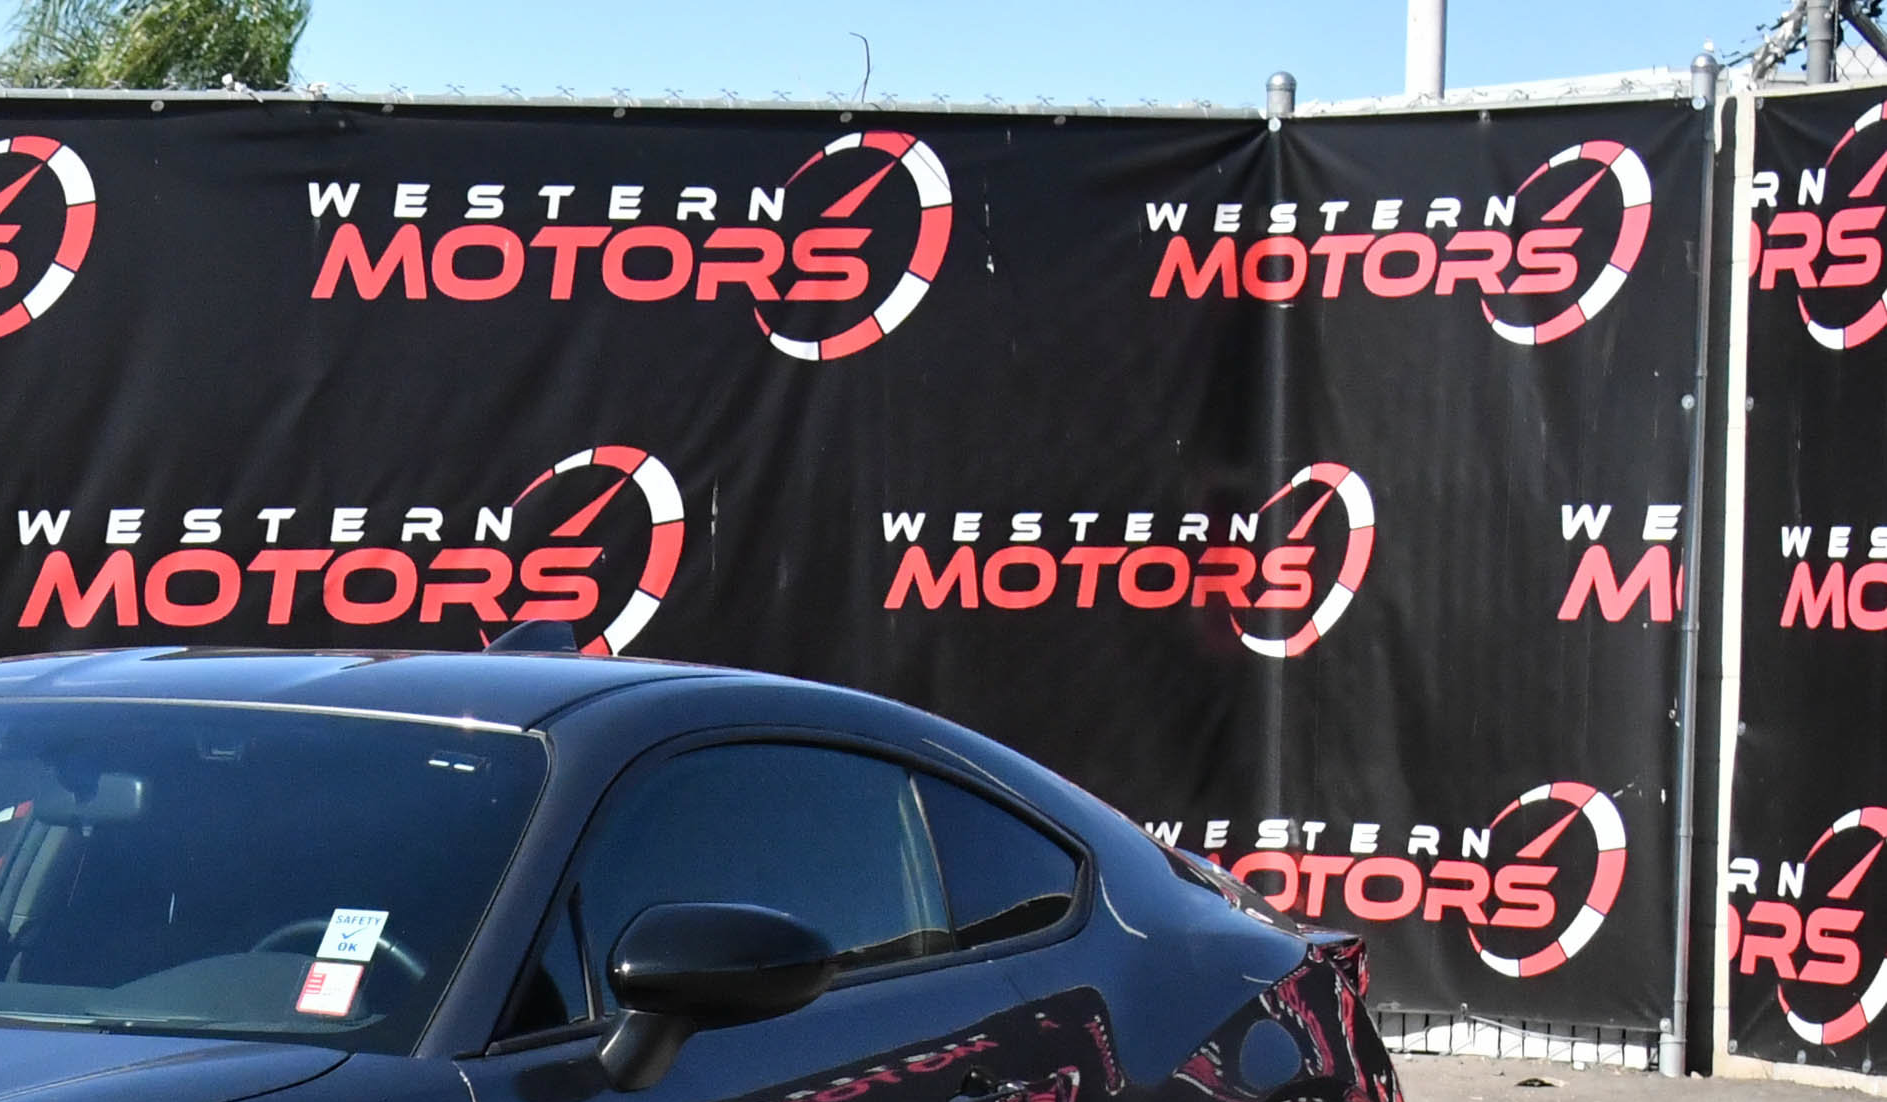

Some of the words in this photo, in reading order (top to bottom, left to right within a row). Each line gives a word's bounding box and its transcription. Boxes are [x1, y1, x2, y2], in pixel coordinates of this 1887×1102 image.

[309, 183, 786, 222] WESTERN
[1146, 196, 1517, 234] WESTERN
[312, 223, 873, 302] MOTORS
[1151, 227, 1584, 302] MOTORS
[18, 507, 514, 546] WESTERN
[883, 512, 1259, 543] WESTERN
[18, 547, 603, 629] MOTORS
[885, 545, 1317, 611] MOTORS
[1145, 819, 1491, 859] WESTERN
[1207, 851, 1559, 929] OTORS
[336, 915, 381, 925] SAFETY
[338, 942, 358, 951] OK
